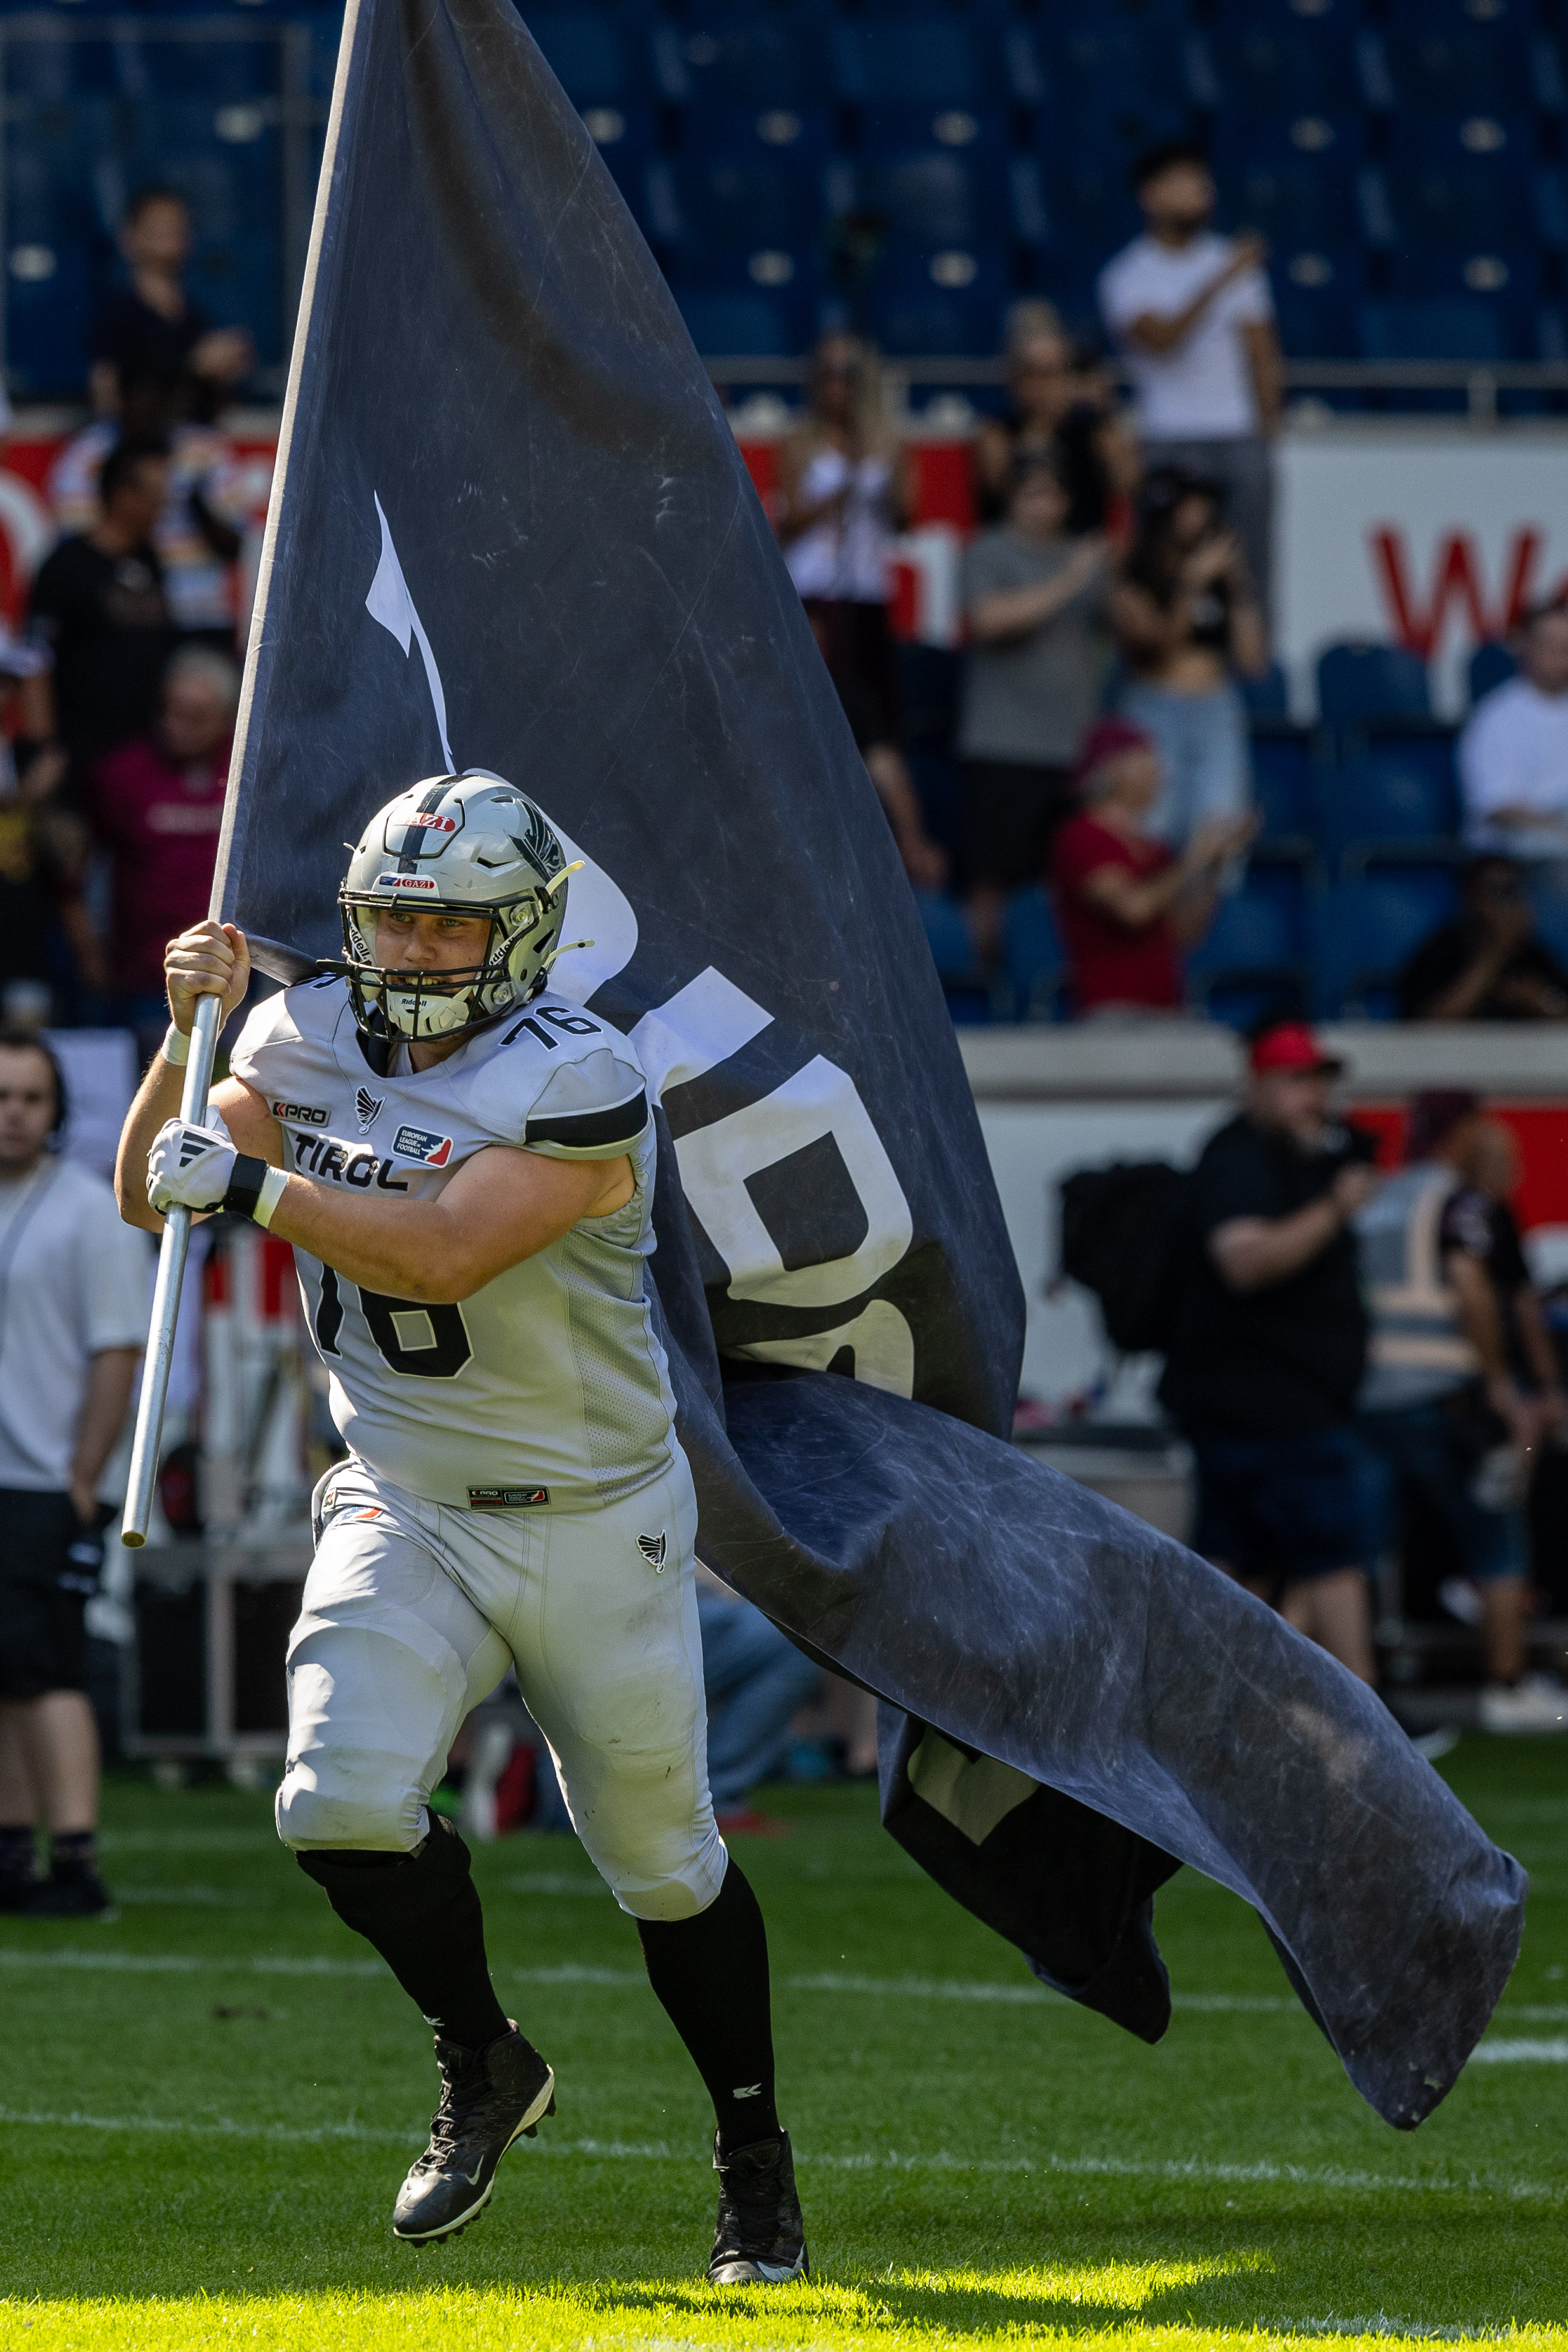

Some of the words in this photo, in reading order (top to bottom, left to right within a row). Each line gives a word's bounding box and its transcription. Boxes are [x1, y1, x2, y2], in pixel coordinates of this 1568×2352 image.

[499, 1005, 604, 1052] 76
[399, 1136, 419, 1147] LEAGUE
[402, 1130, 428, 1142] EUROPEAN
[397, 1143, 421, 1155] FOOTBALL
[295, 1133, 409, 1192] TIROL
